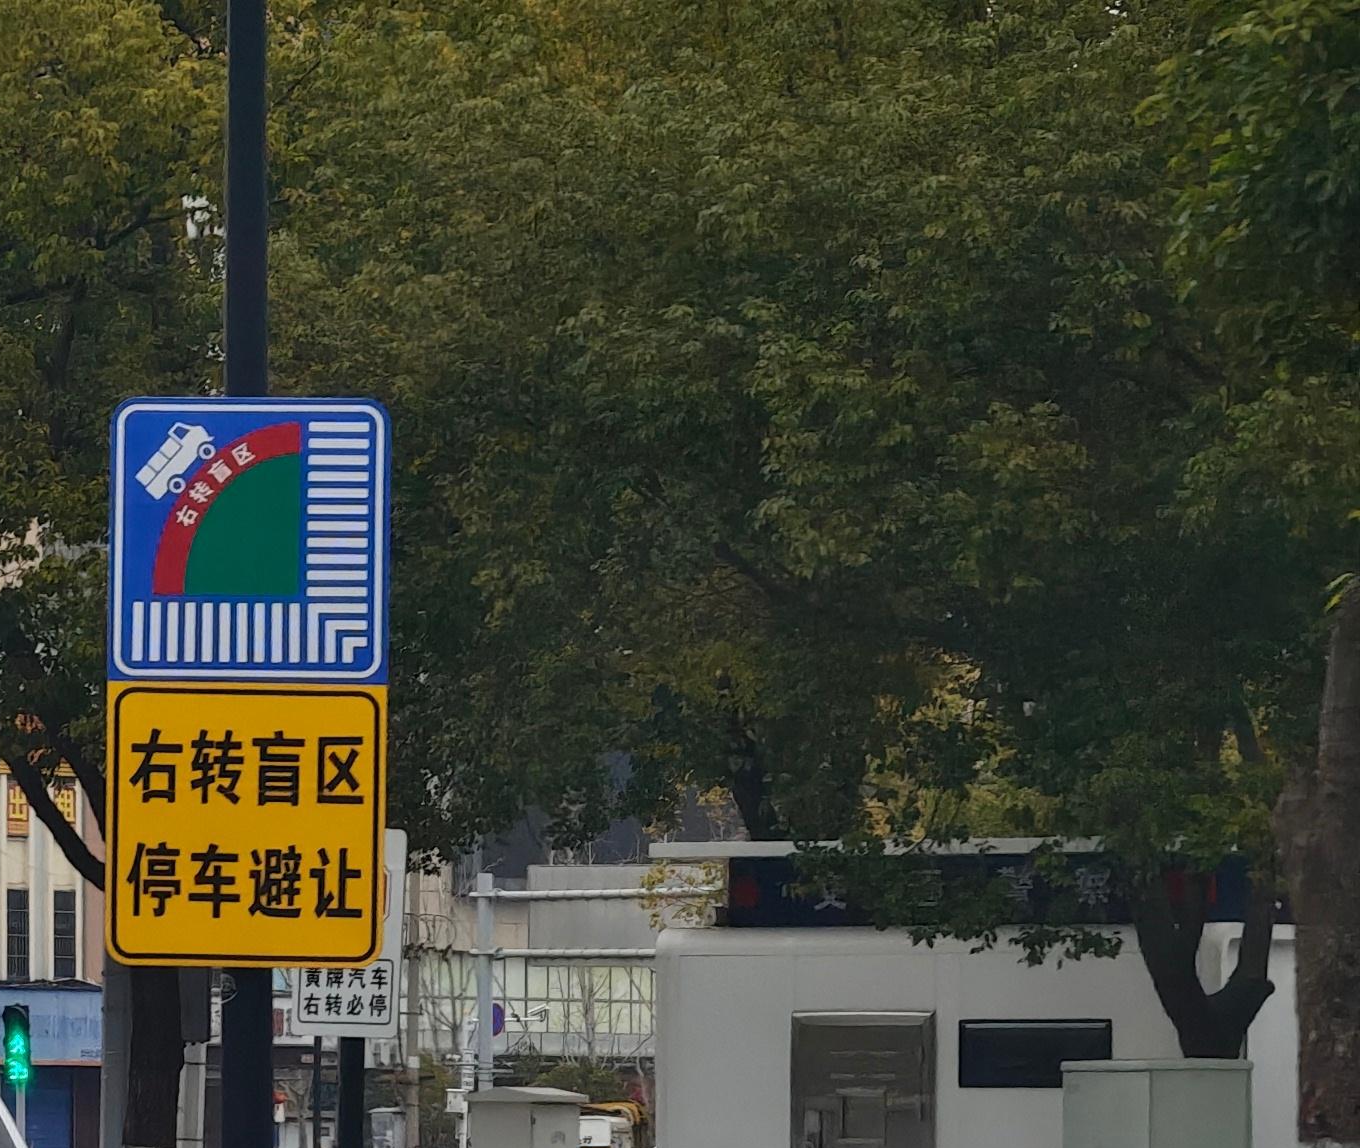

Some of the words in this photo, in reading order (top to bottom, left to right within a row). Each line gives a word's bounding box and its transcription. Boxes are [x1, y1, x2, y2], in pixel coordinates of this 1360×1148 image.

[175, 442, 257, 527] 右转盲区
[129, 728, 365, 807] 右转盲区
[127, 842, 363, 919] 停车避让
[303, 993, 387, 1017] 右转必停
[305, 966, 389, 990] 黄牌汽车
